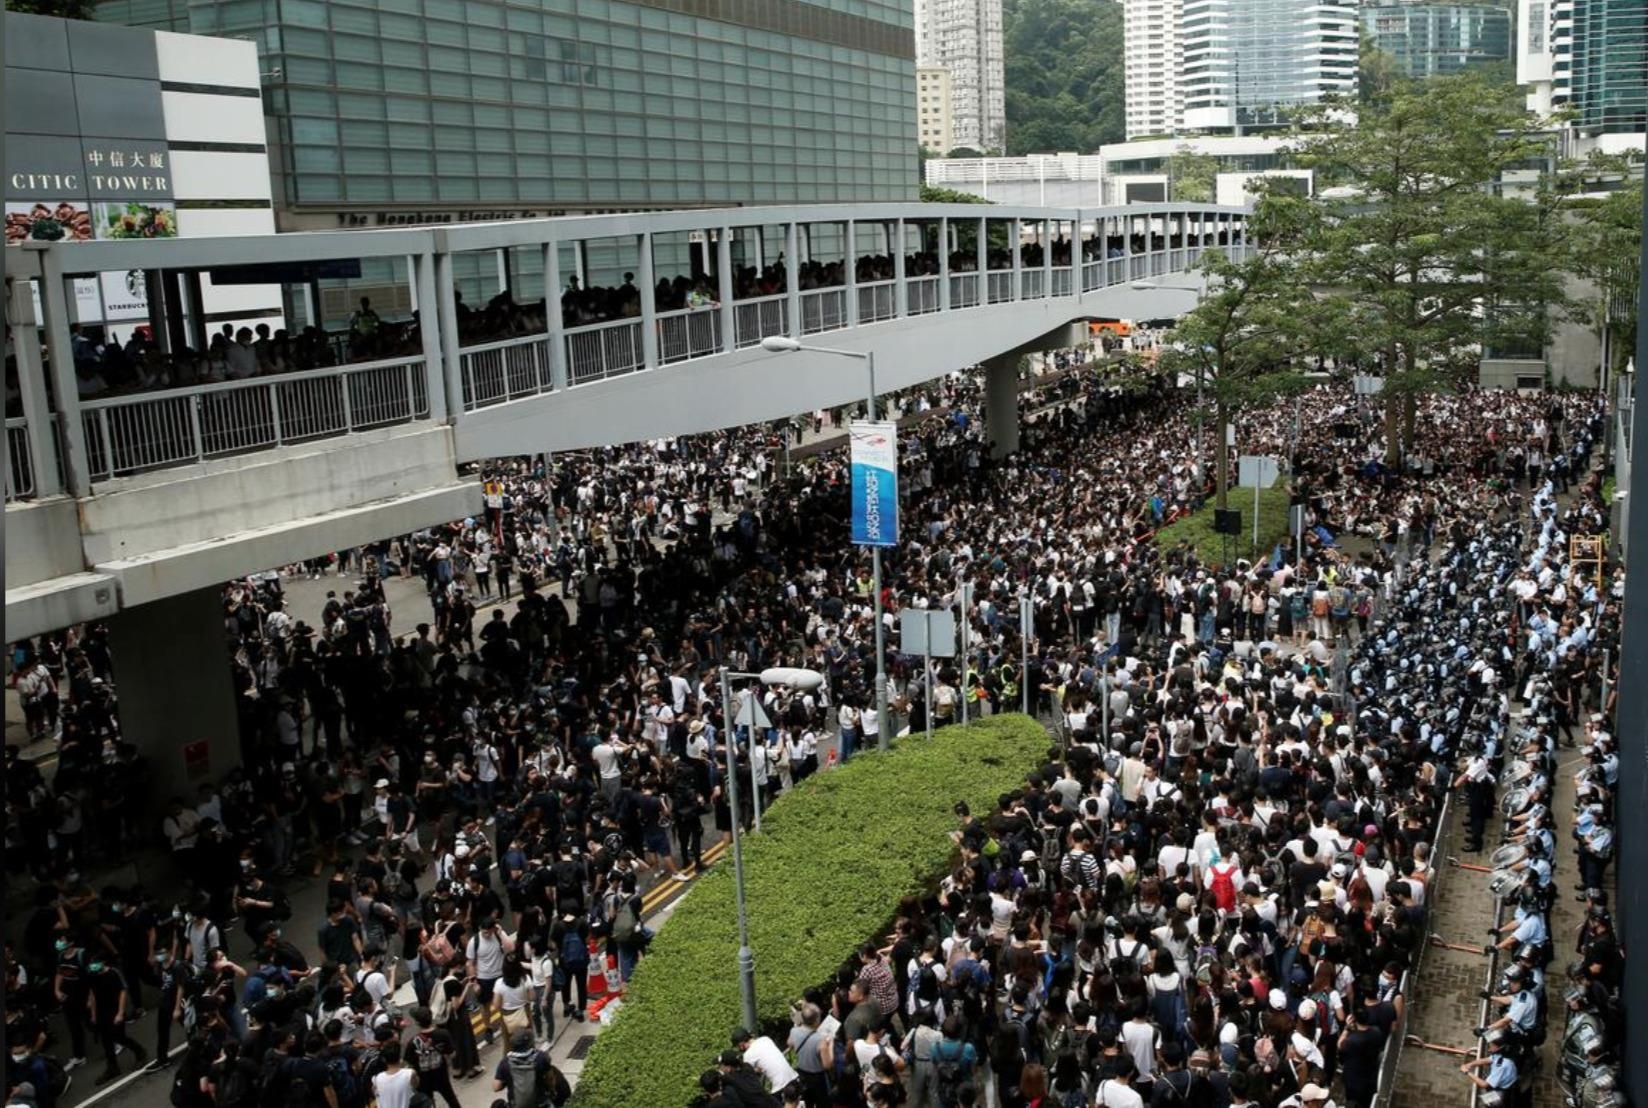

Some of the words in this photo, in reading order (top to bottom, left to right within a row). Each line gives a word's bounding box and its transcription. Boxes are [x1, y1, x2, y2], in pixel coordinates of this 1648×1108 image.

[11, 173, 77, 190] CITIC
[92, 175, 168, 191] TOWER
[337, 212, 368, 225] The
[459, 210, 516, 222] Electric
[108, 303, 149, 311] STARBUCK
